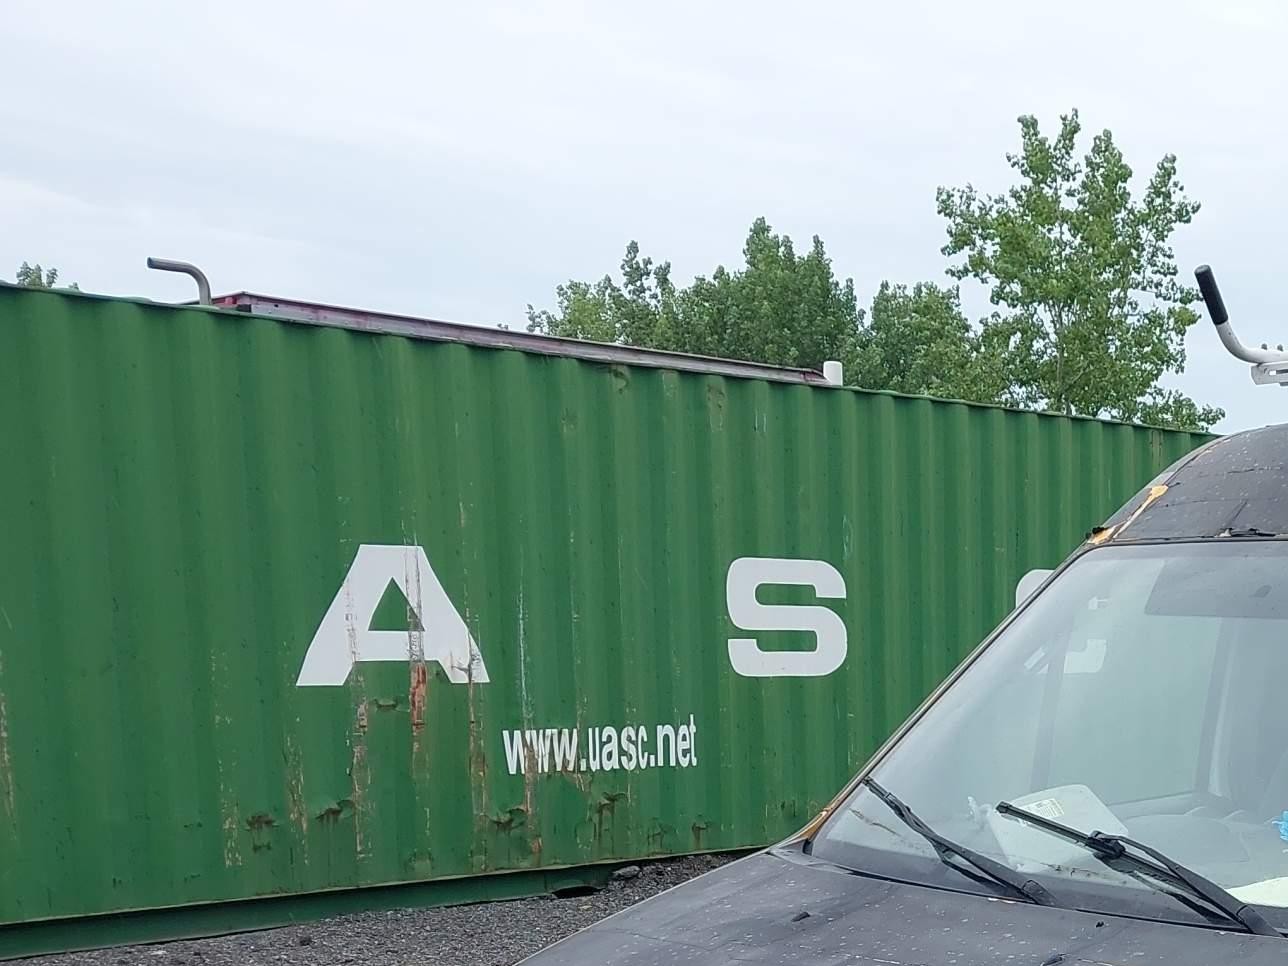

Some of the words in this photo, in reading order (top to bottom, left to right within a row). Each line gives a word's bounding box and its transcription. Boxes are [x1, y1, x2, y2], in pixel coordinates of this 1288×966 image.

[296, 544, 490, 687] A
[726, 557, 848, 677] S
[502, 713, 697, 775] www.uasc.net
